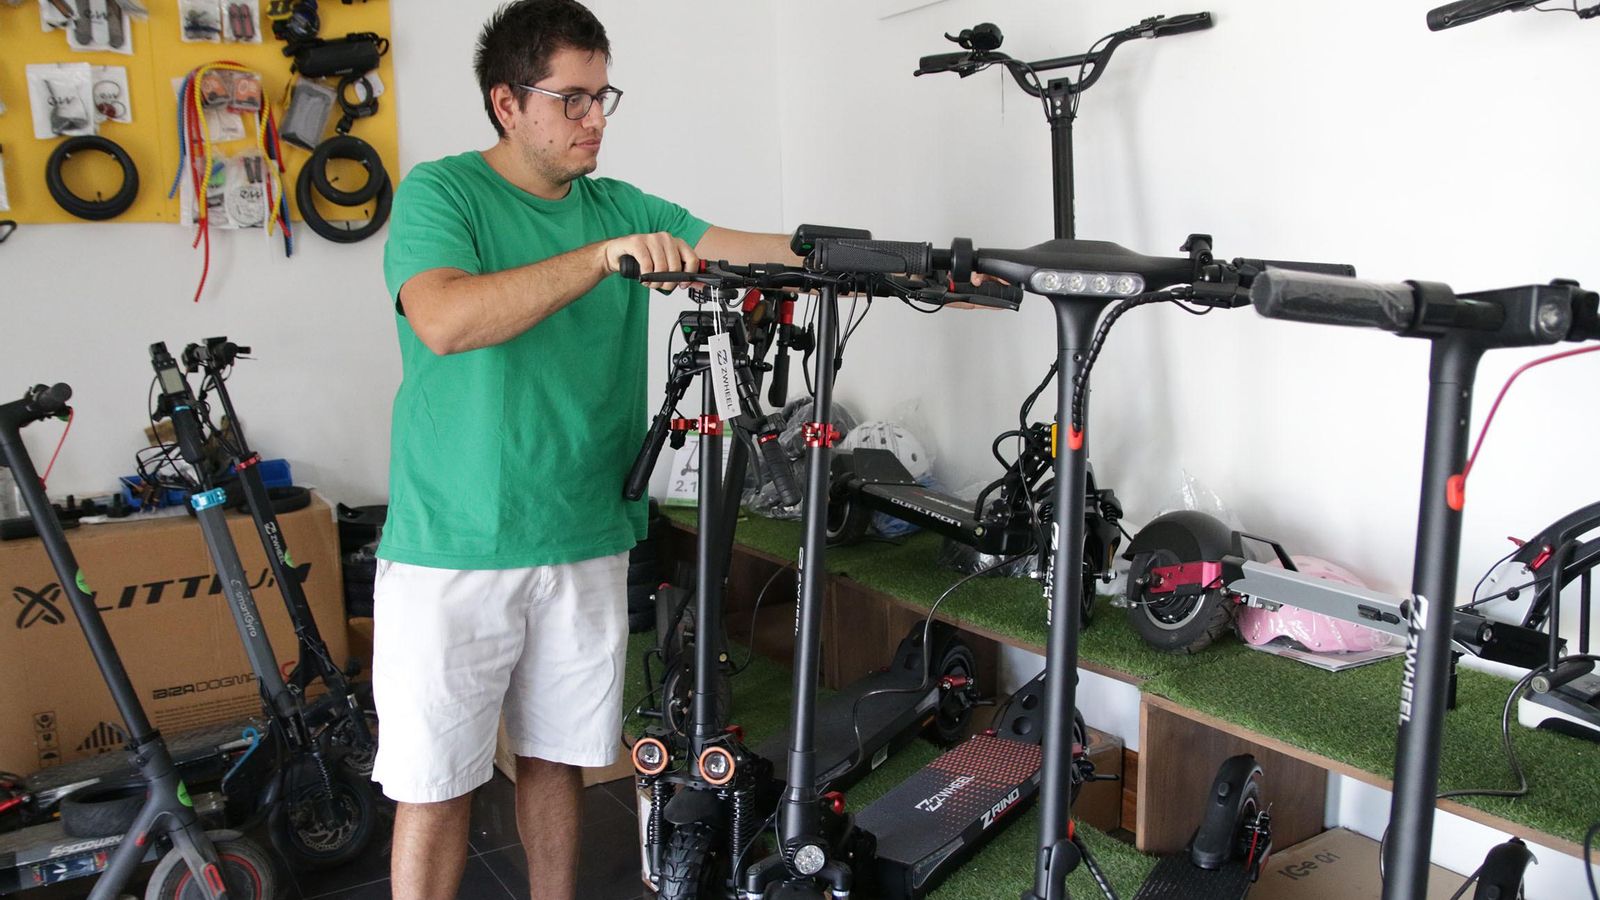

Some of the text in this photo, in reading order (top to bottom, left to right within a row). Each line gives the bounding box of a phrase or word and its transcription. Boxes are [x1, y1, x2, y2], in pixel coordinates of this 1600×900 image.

[721, 367, 733, 410] ZWHEEL
[270, 535, 285, 565] ZWHEEL
[1399, 633, 1419, 726] ZWHEEL
[930, 776, 976, 803] ZWHEEL
